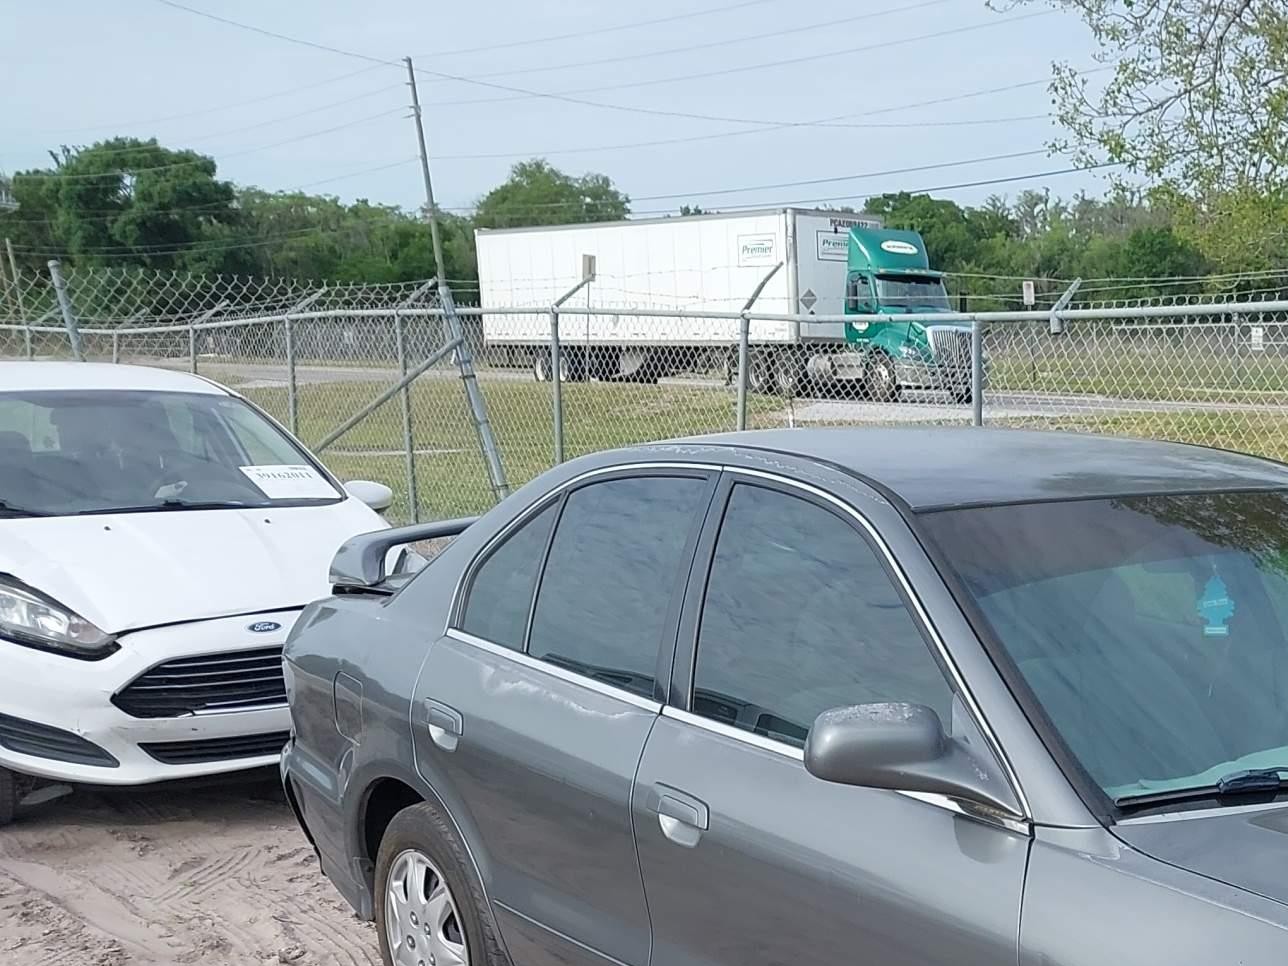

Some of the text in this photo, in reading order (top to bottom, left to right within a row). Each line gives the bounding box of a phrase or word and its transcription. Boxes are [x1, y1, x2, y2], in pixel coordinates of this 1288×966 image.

[822, 239, 848, 248] Premi
[741, 245, 773, 255] Premier
[254, 623, 275, 631] Ford
